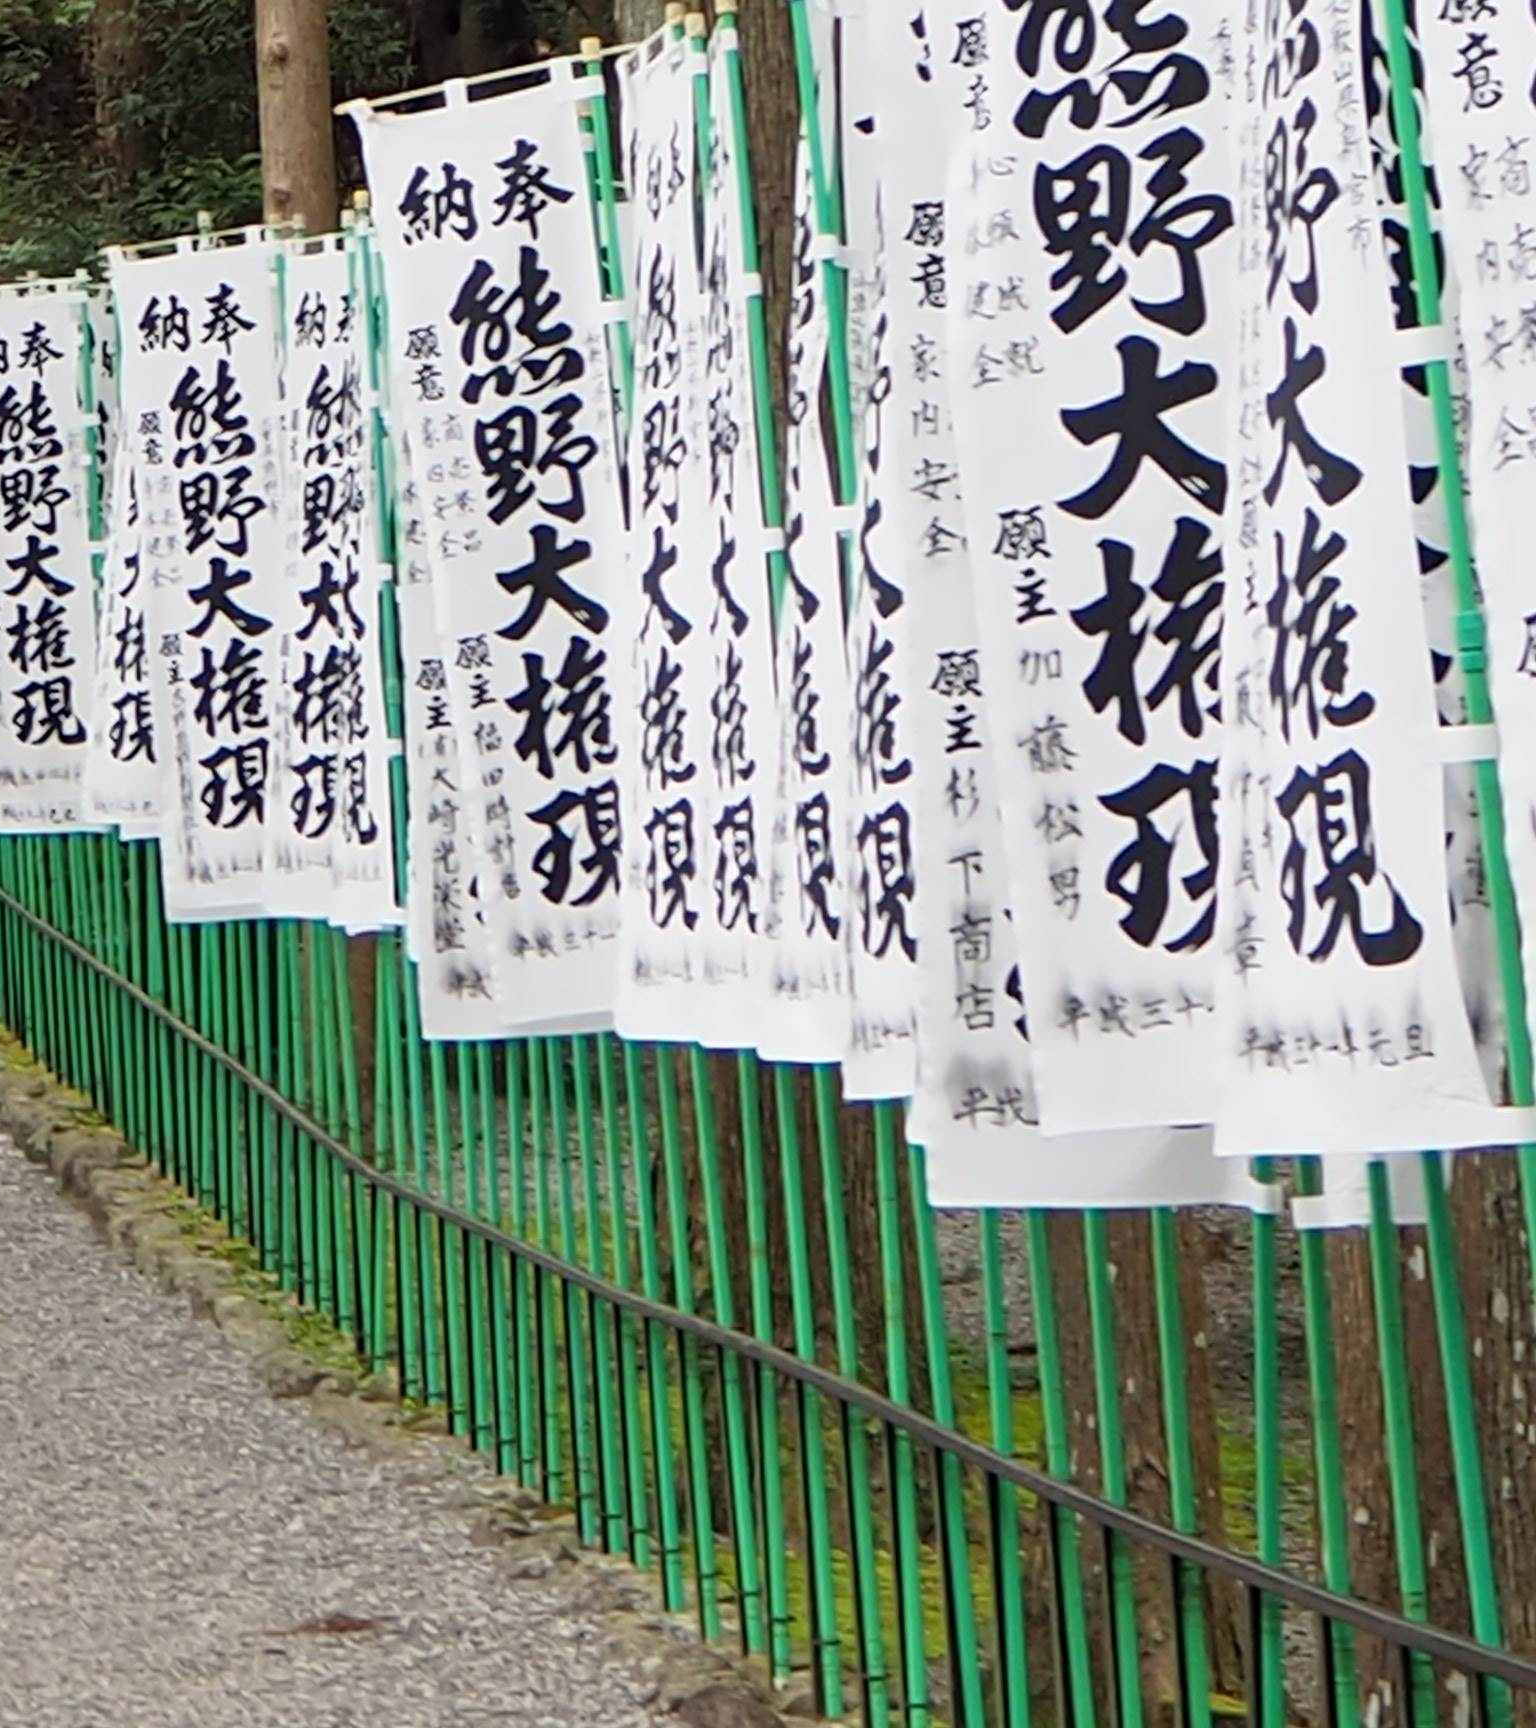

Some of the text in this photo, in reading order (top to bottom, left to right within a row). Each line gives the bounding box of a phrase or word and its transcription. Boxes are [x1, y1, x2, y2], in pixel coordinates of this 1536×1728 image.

[950, 12, 991, 132] 願意
[398, 138, 575, 246] 奉納
[138, 282, 257, 356] 奉納
[404, 324, 445, 401] 願意
[137, 410, 163, 466] 願意
[169, 358, 275, 830] 熊野大権現
[448, 245, 623, 907] 熊野大権現
[993, 504, 1057, 625] 願主
[159, 632, 186, 687] 願主
[415, 658, 452, 730] 願主
[455, 633, 497, 709] 願主
[929, 648, 984, 754] 願主
[945, 765, 995, 1031] 杉下商店
